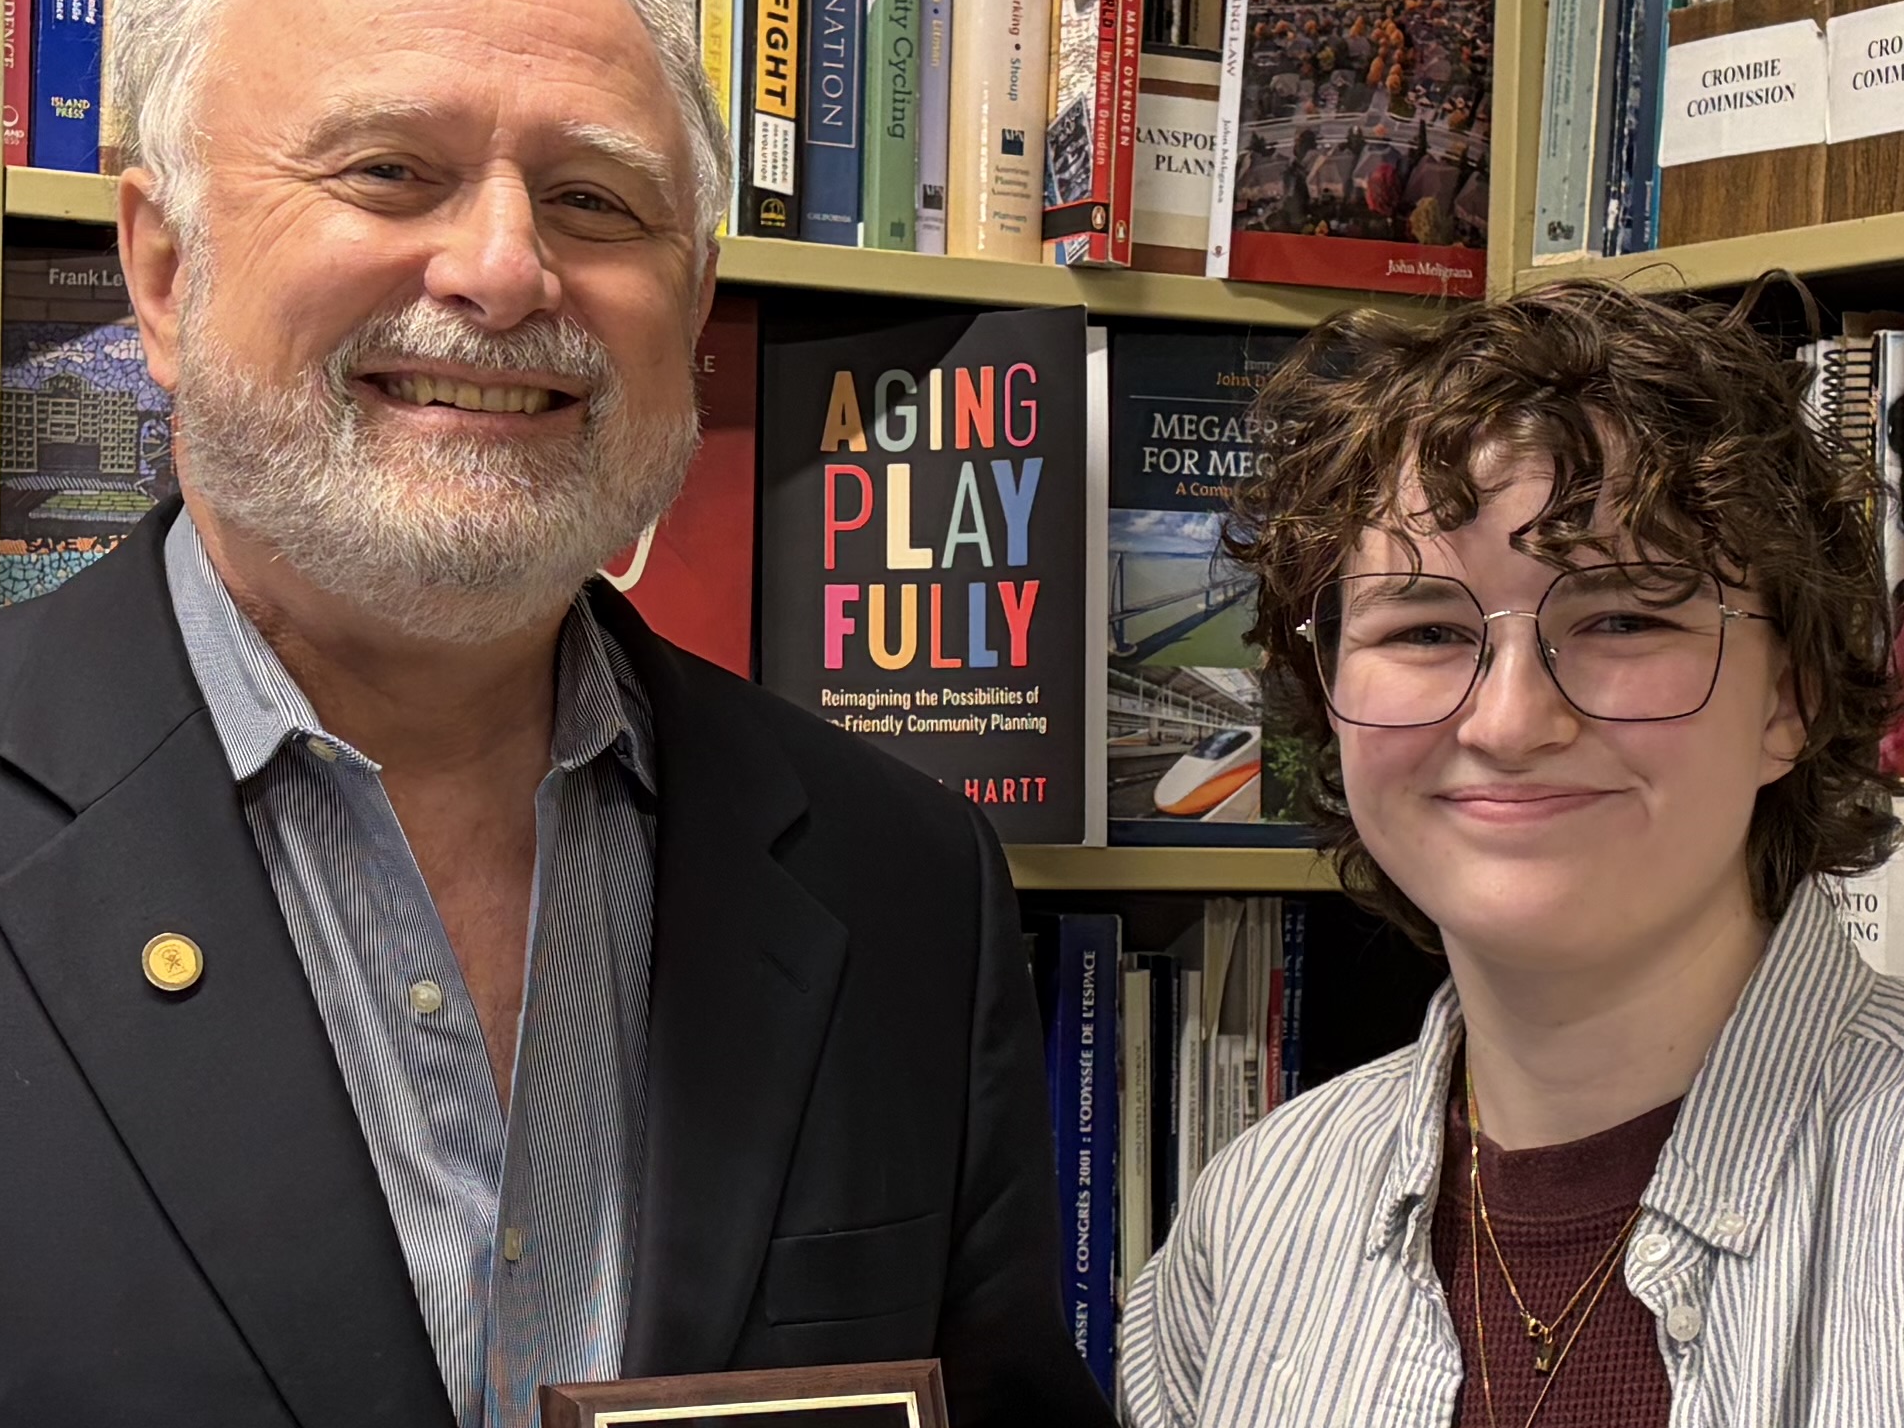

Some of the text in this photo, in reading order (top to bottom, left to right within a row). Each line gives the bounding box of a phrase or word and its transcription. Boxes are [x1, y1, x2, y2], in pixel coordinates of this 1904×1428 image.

[887, 36, 915, 141] Cycling
[1700, 57, 1782, 89] CROMBIE
[1687, 81, 1797, 117] COMMISSION
[820, 363, 1037, 453] AGING
[823, 456, 1044, 572] PLAY
[823, 580, 1040, 671] FULLY
[821, 685, 1040, 710] Reimagining the Possibilities of
[907, 711, 1048, 734] Community Planning
[965, 777, 1047, 803] HARTT
[1082, 950, 1096, 1018] L'ESPACE
[1081, 1026, 1094, 1044] DE
